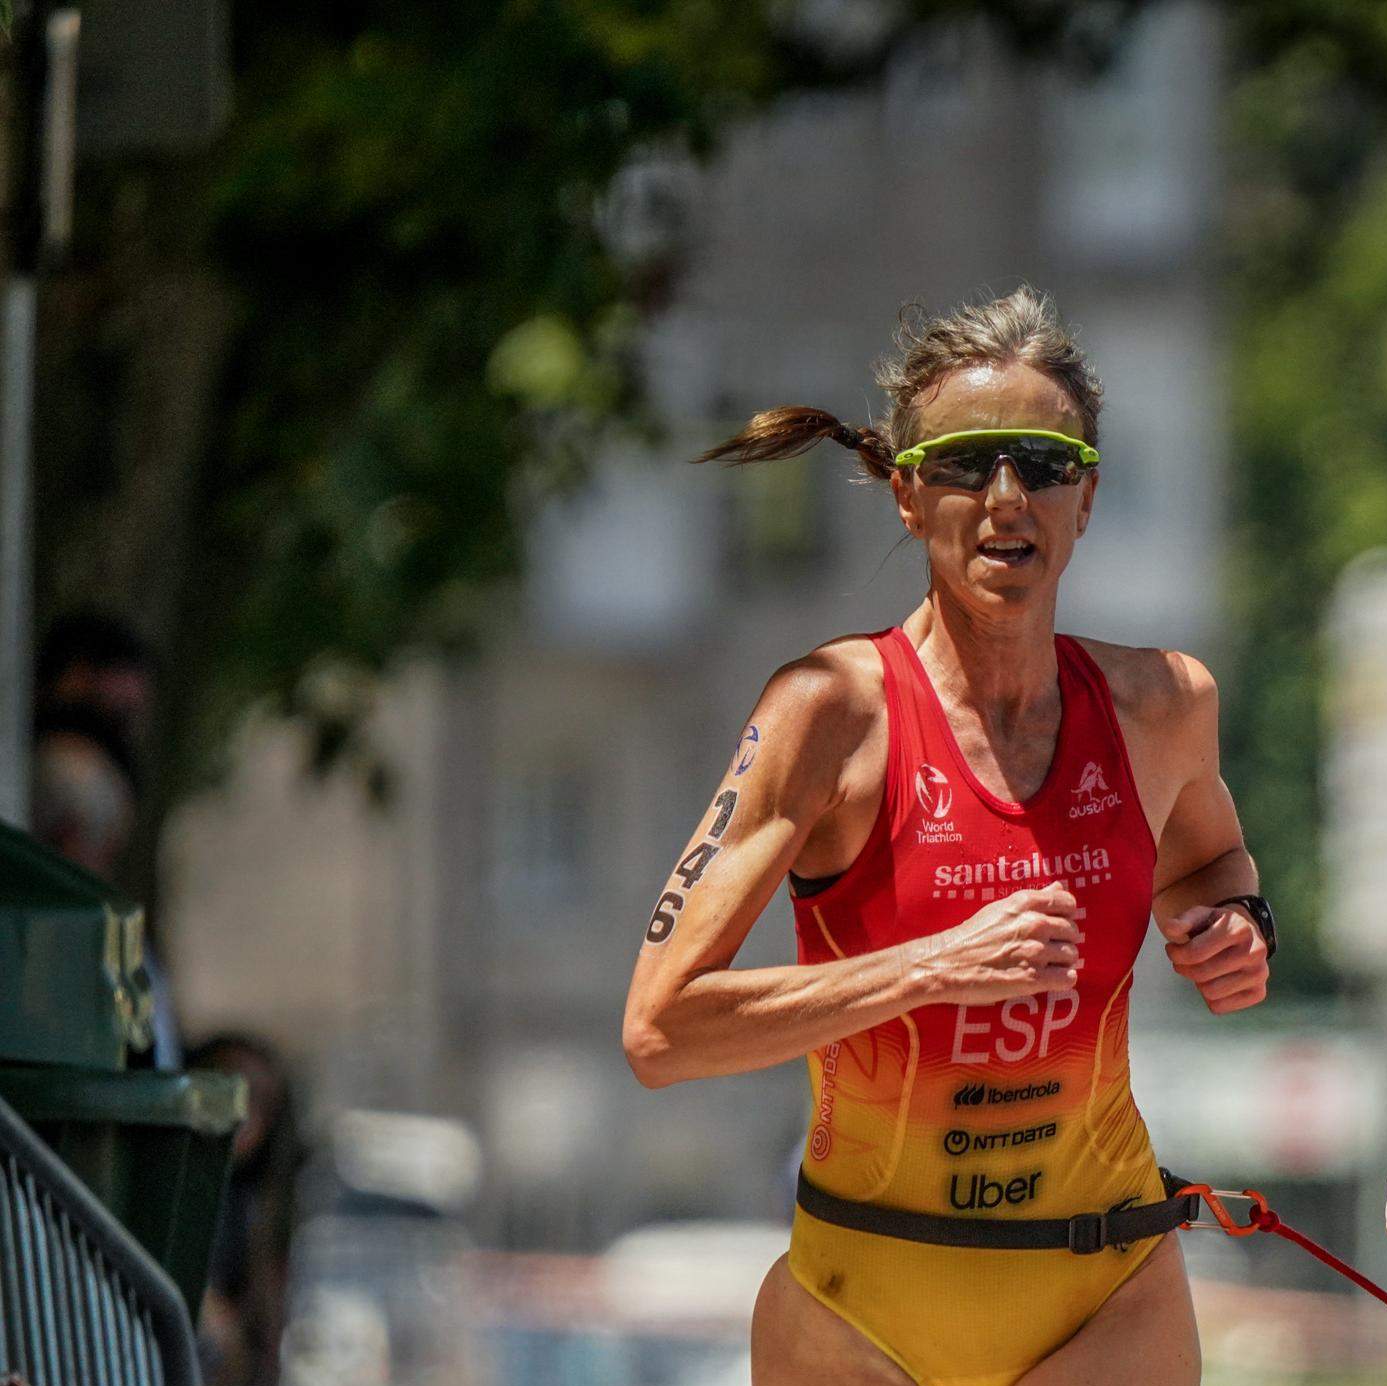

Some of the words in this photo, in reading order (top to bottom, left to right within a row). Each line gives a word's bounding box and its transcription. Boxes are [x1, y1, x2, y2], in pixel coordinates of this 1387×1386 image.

[1069, 792, 1122, 819] austral
[916, 831, 962, 844] Triathlon
[922, 819, 955, 832] World
[646, 789, 738, 943] 146
[934, 844, 1110, 886] santalucía
[952, 988, 1080, 1064] ESP
[987, 1081, 1060, 1100] Iberdrola
[973, 1134, 1010, 1150] NTT
[950, 1172, 1042, 1211] Uber
